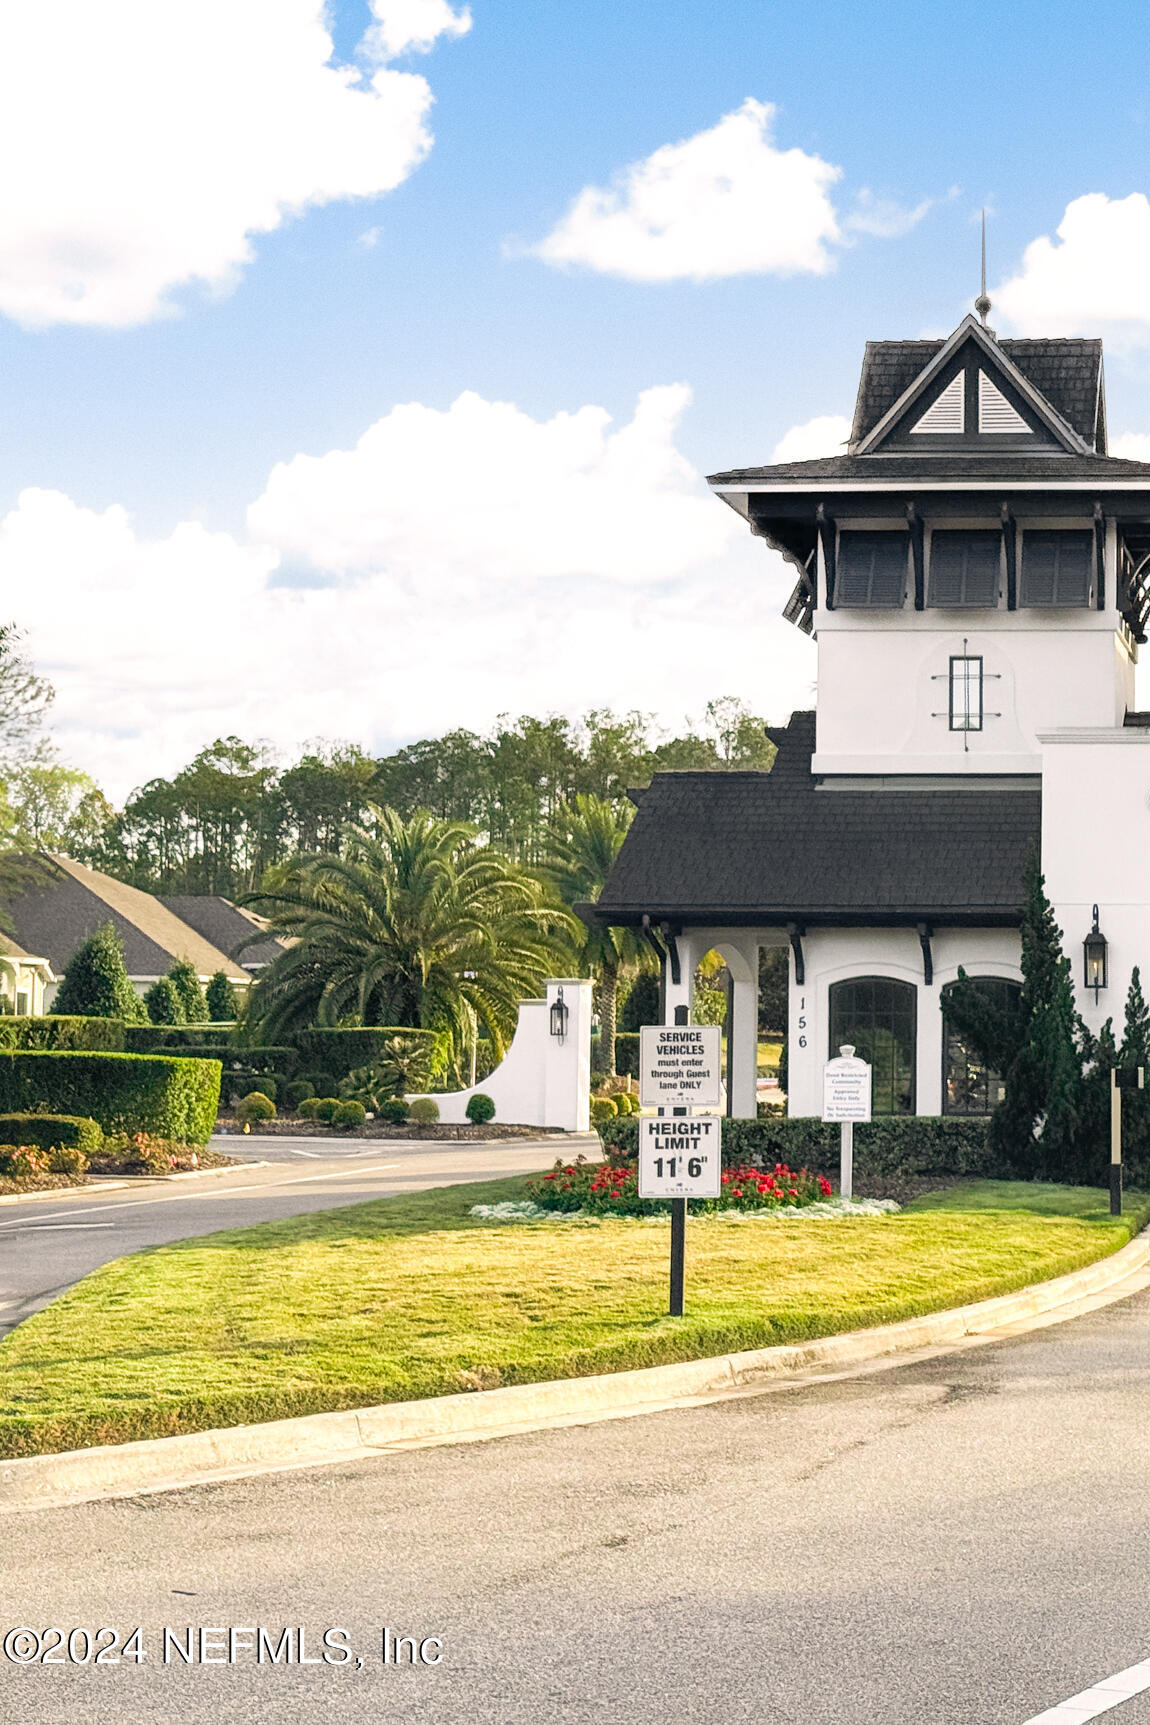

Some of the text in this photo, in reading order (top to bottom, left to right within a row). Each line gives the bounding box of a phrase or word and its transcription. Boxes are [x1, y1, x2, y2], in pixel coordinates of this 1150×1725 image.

[798, 997, 807, 1048] 156
[659, 1032, 702, 1042] SERVICE
[656, 1045, 704, 1055] VEHICLES
[658, 1059, 704, 1067] must enter
[651, 1070, 710, 1079] through Guest
[659, 1081, 702, 1089] lane ONLY
[649, 1123, 712, 1135] HEIGHT
[655, 1138, 701, 1149] LIMIT
